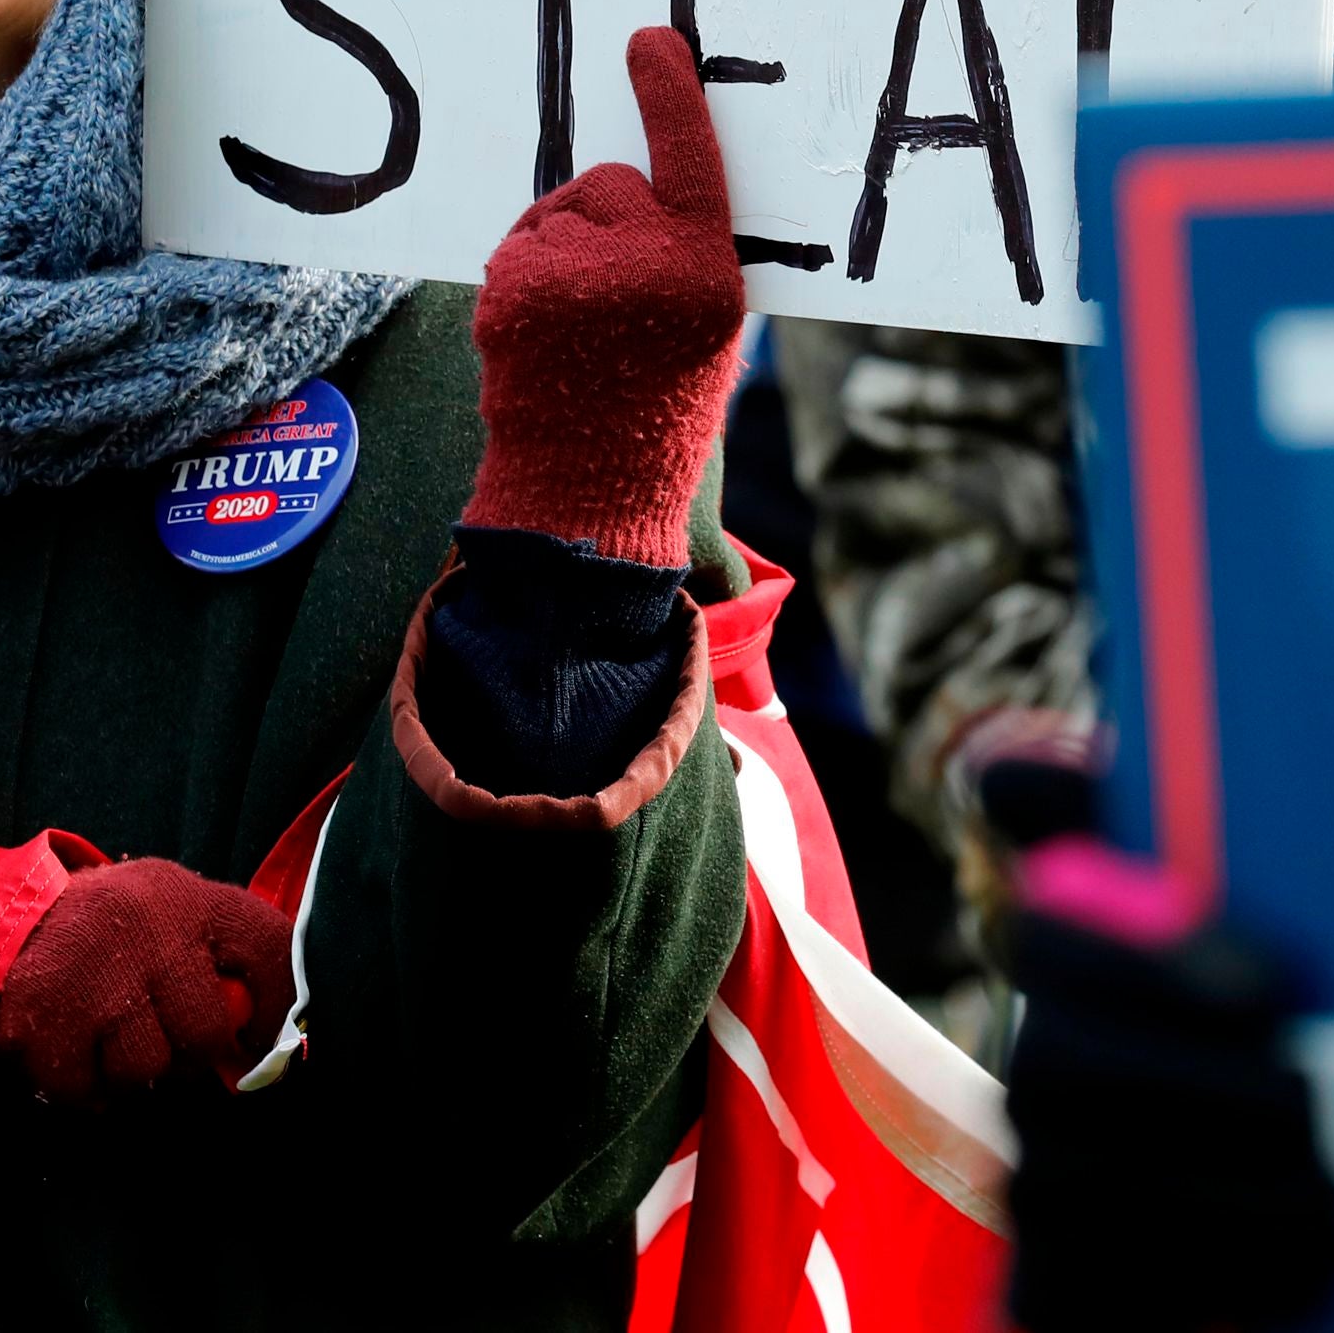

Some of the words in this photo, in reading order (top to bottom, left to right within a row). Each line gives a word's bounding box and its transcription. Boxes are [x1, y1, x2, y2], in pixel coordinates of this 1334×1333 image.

[217, 427, 271, 446] RICA
[273, 422, 338, 442] GREAT
[171, 446, 338, 493] TRUMP
[213, 495, 269, 520] 2020
